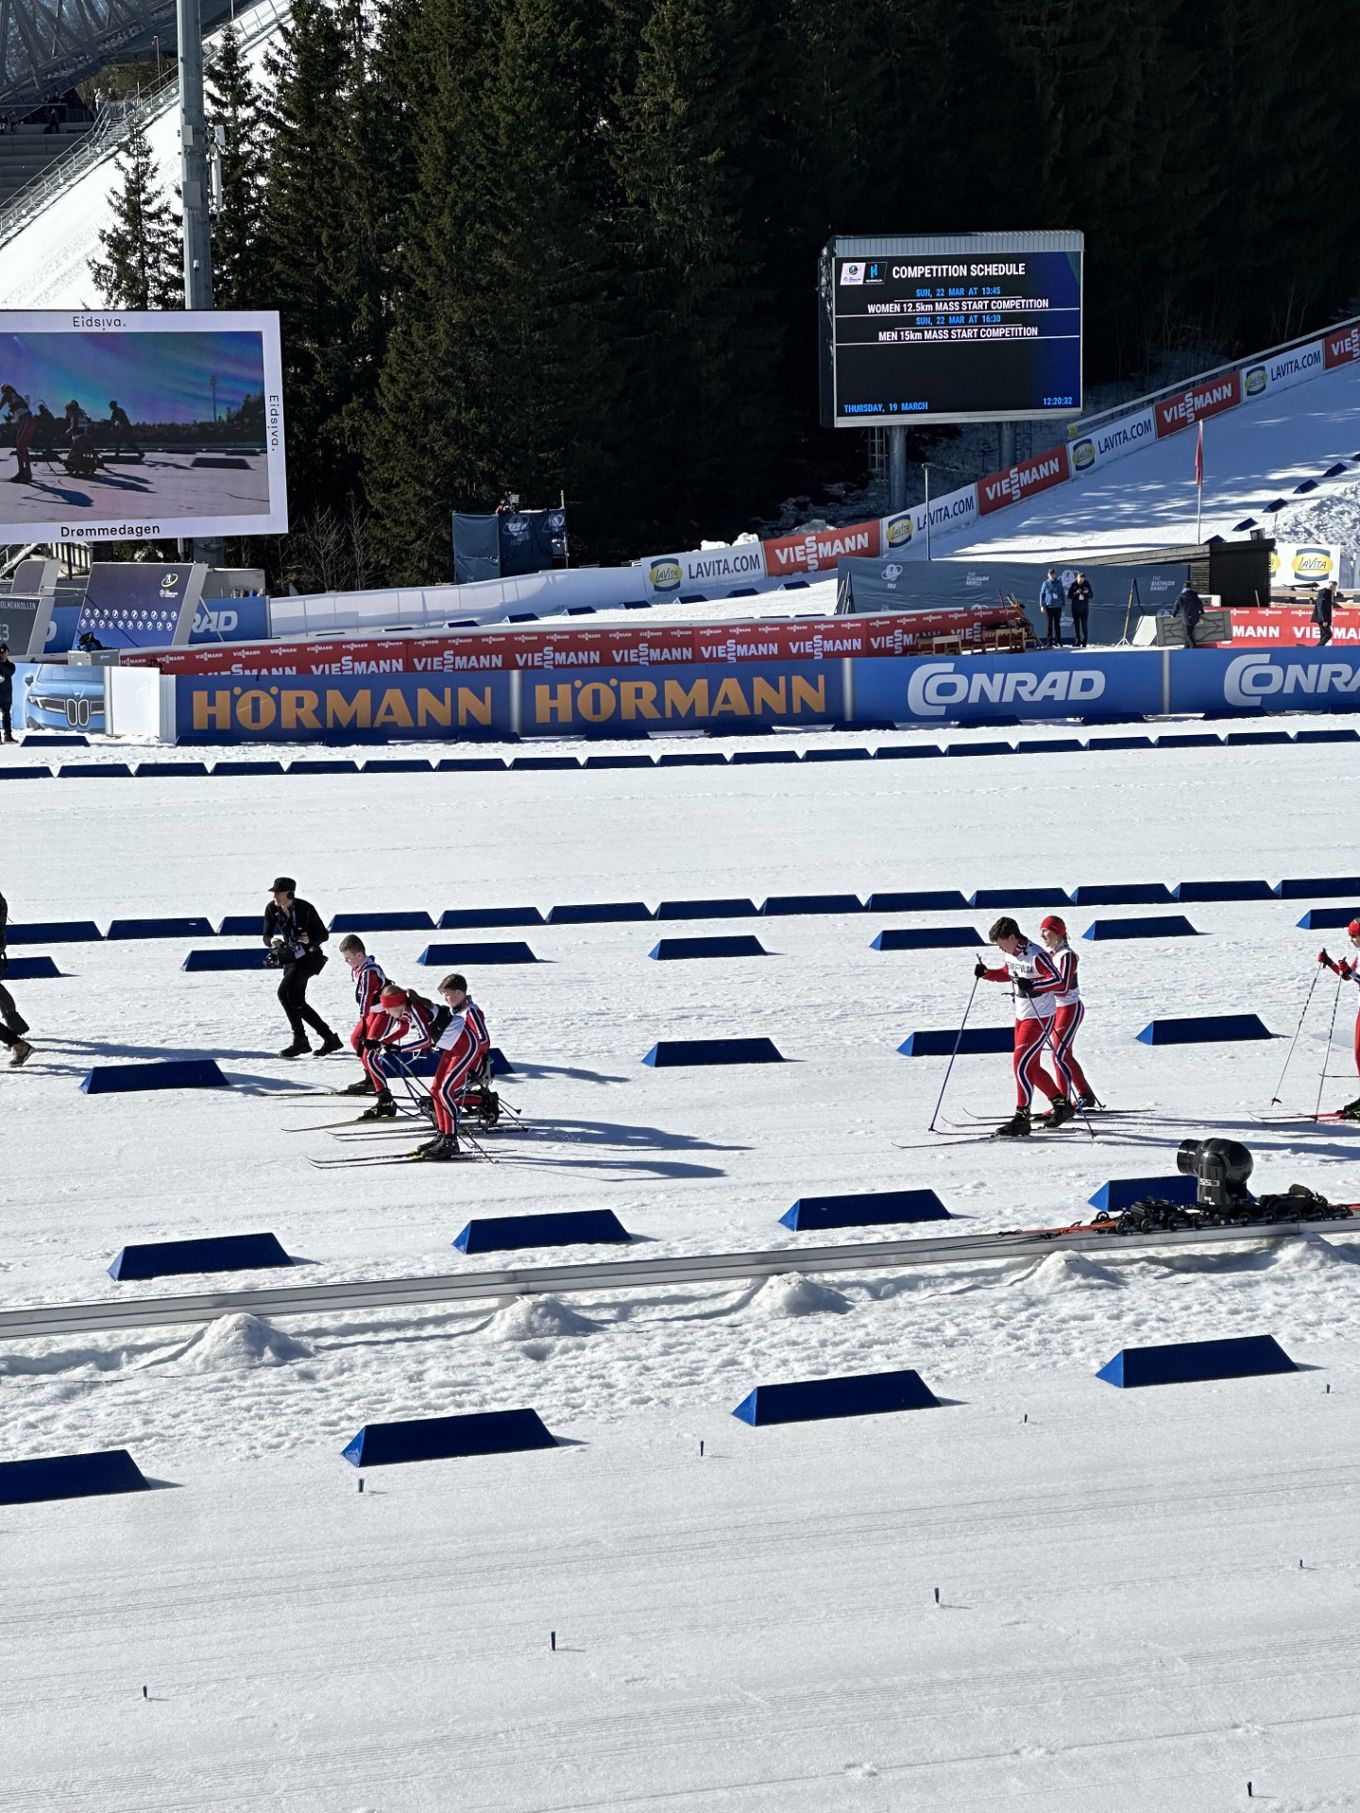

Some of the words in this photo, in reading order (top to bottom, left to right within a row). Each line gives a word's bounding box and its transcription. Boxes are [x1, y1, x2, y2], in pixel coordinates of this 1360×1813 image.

[892, 265, 968, 279] COMPETITION
[970, 263, 1026, 276] SCHEDULE
[916, 288, 933, 298] SUN,
[936, 288, 945, 297] 22
[949, 287, 965, 296] MAR
[968, 287, 978, 295] AT
[982, 286, 1001, 295] 13:45
[867, 304, 901, 314] WOMEN
[902, 303, 933, 313] 12.5km
[935, 302, 960, 312] MASS
[961, 301, 989, 310] START
[991, 299, 1049, 310] COMPETITION
[73, 316, 127, 330] Eidsiva.
[916, 317, 933, 326] SUN,
[936, 316, 945, 325] 22
[949, 315, 965, 325] MAR
[968, 315, 978, 323] AT
[982, 314, 1001, 323] 16:30
[879, 331, 898, 341] MEN
[900, 331, 923, 341] 15km
[924, 330, 949, 340] MASS
[951, 328, 978, 339] START
[980, 327, 1038, 338] COMPETITION
[1331, 328, 1360, 359] VIESS
[1271, 350, 1321, 381] LAVITA.COM
[844, 404, 885, 414] THURSDAY,
[889, 403, 898, 412] 19
[902, 402, 928, 411] MARCH
[1043, 396, 1073, 406] 12:20:32
[1163, 383, 1233, 424] VIESSMANN
[1098, 418, 1152, 454] LAVITA.COM
[985, 457, 1060, 500] VIESSMANN
[917, 496, 975, 531] LAVITA.COM
[60, 524, 160, 538] Drømmedagen
[775, 535, 869, 572] VIESSMANN
[688, 554, 761, 580] LAVITA.COM
[701, 639, 778, 663] VIESSMANN
[789, 634, 862, 660] VIESSMANN
[908, 662, 1106, 716] CONRAD
[1224, 653, 1360, 706] CONR
[193, 686, 492, 730] HÖRMANN
[535, 675, 826, 723] HÖRMANN
